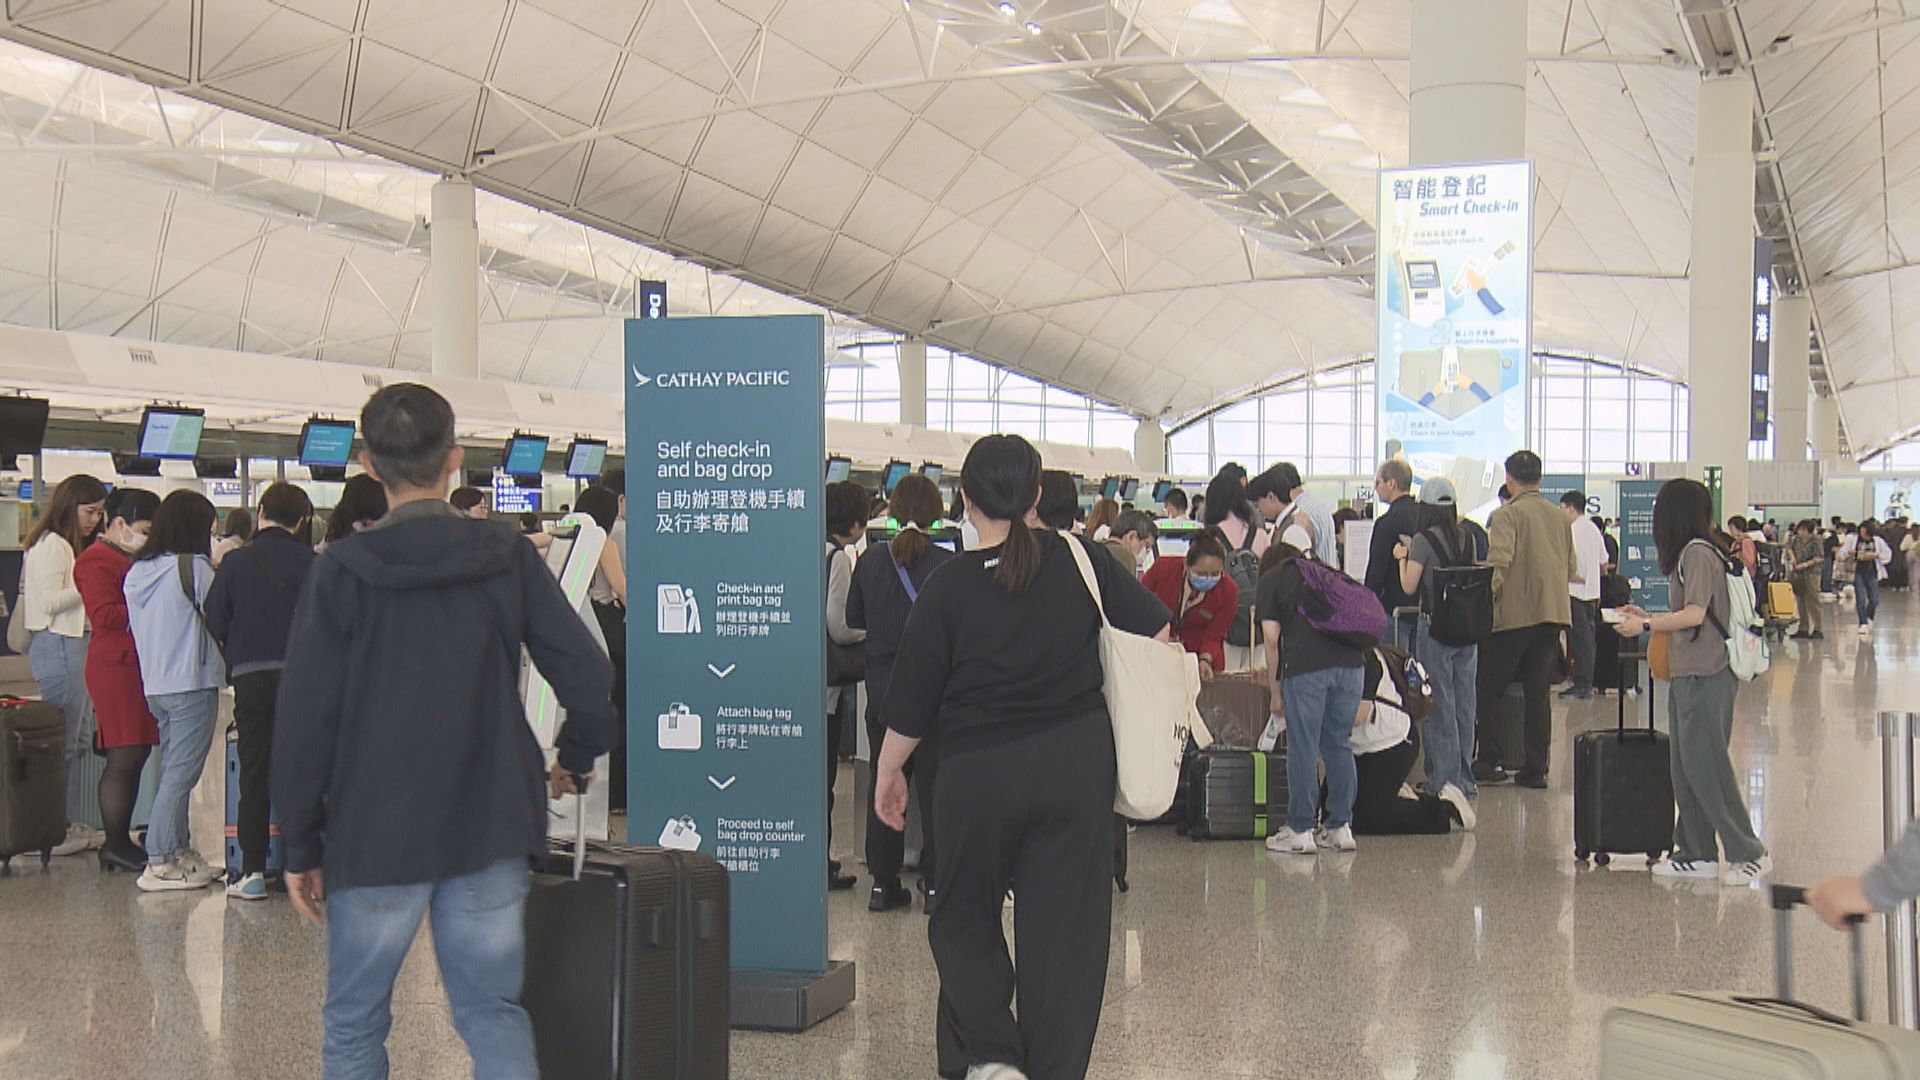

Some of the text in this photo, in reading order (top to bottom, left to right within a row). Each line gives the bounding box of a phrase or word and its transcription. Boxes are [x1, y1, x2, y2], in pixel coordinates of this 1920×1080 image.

[1393, 174, 1486, 200] 智能登記
[1419, 201, 1459, 216] Smart
[656, 370, 790, 388] CATHAY PACIFIC
[657, 440, 771, 459] Self check-in
[657, 461, 773, 481] and bag drop
[656, 489, 805, 510] 自助辦理登機手續
[656, 514, 750, 534] 及行李寄艙
[716, 582, 784, 594] Check-in and
[716, 594, 782, 607] print bag tag
[716, 624, 770, 637] 列印行李牌
[717, 706, 792, 721] Attach bag tag
[716, 737, 749, 750] 行李上
[717, 818, 795, 830] Proceed to self
[717, 829, 806, 843] bag drop counter
[717, 846, 780, 860] 前往自助行李
